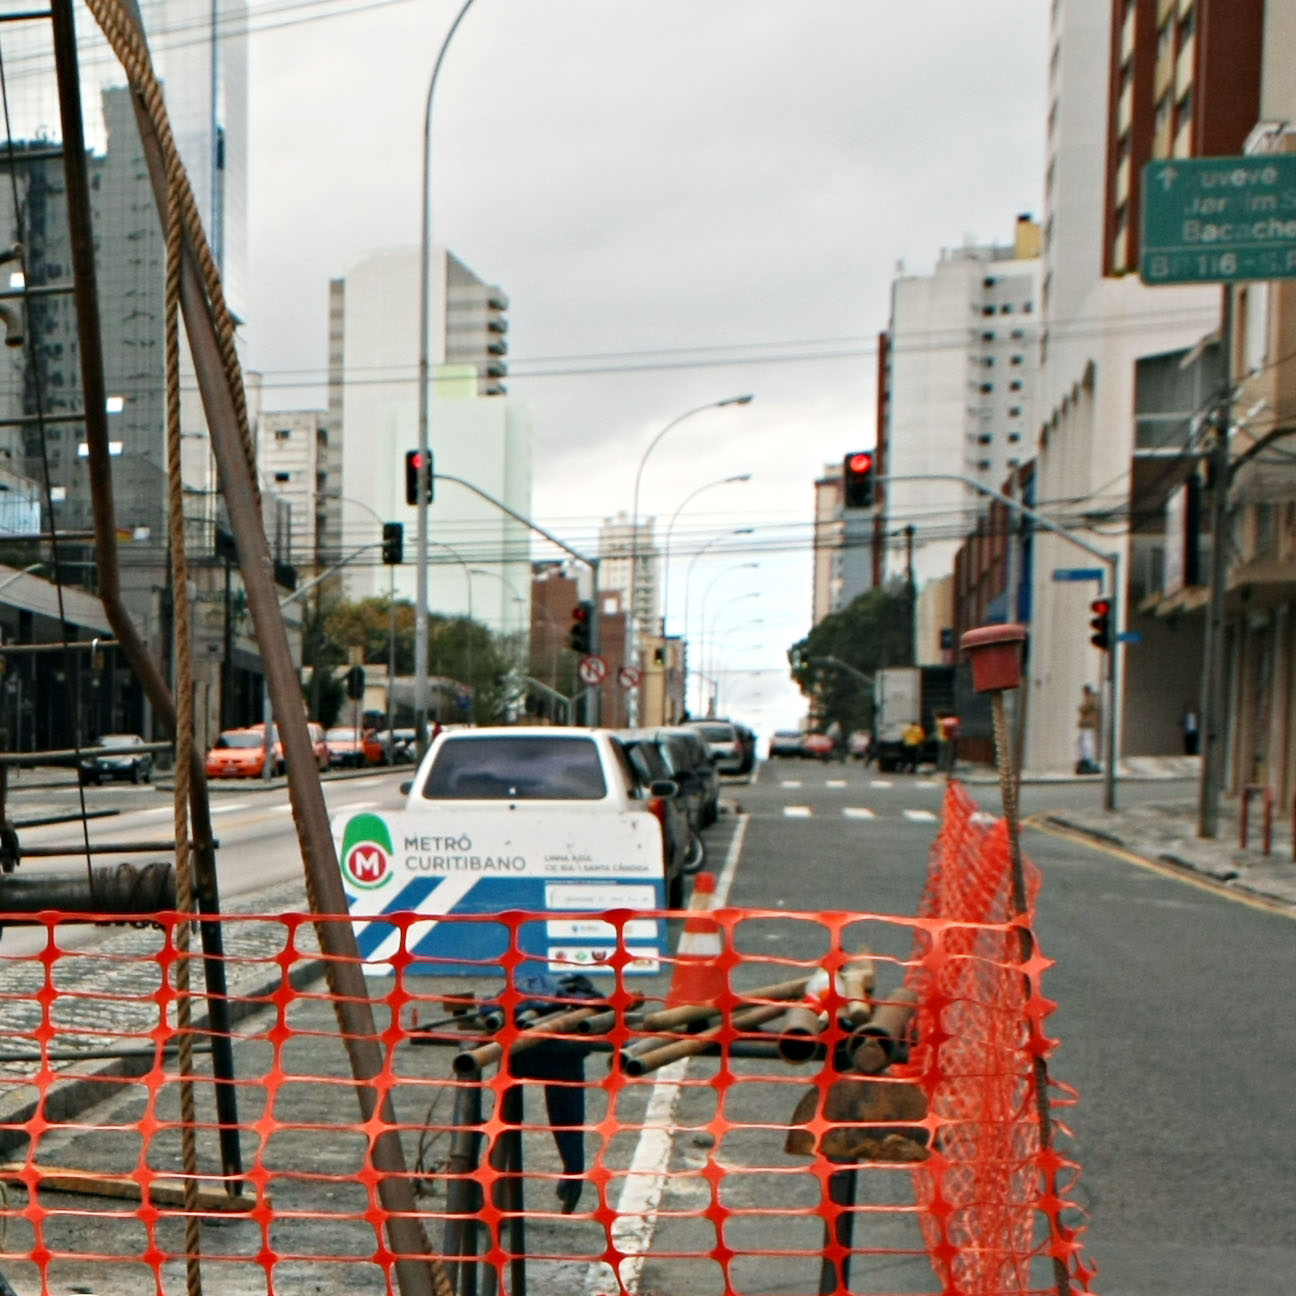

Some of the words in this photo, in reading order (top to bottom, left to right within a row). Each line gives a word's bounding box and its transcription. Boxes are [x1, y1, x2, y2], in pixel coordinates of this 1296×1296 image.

[404, 832, 472, 851] METRÔ
[354, 851, 380, 877] M
[405, 855, 527, 872] CURITIBANO
